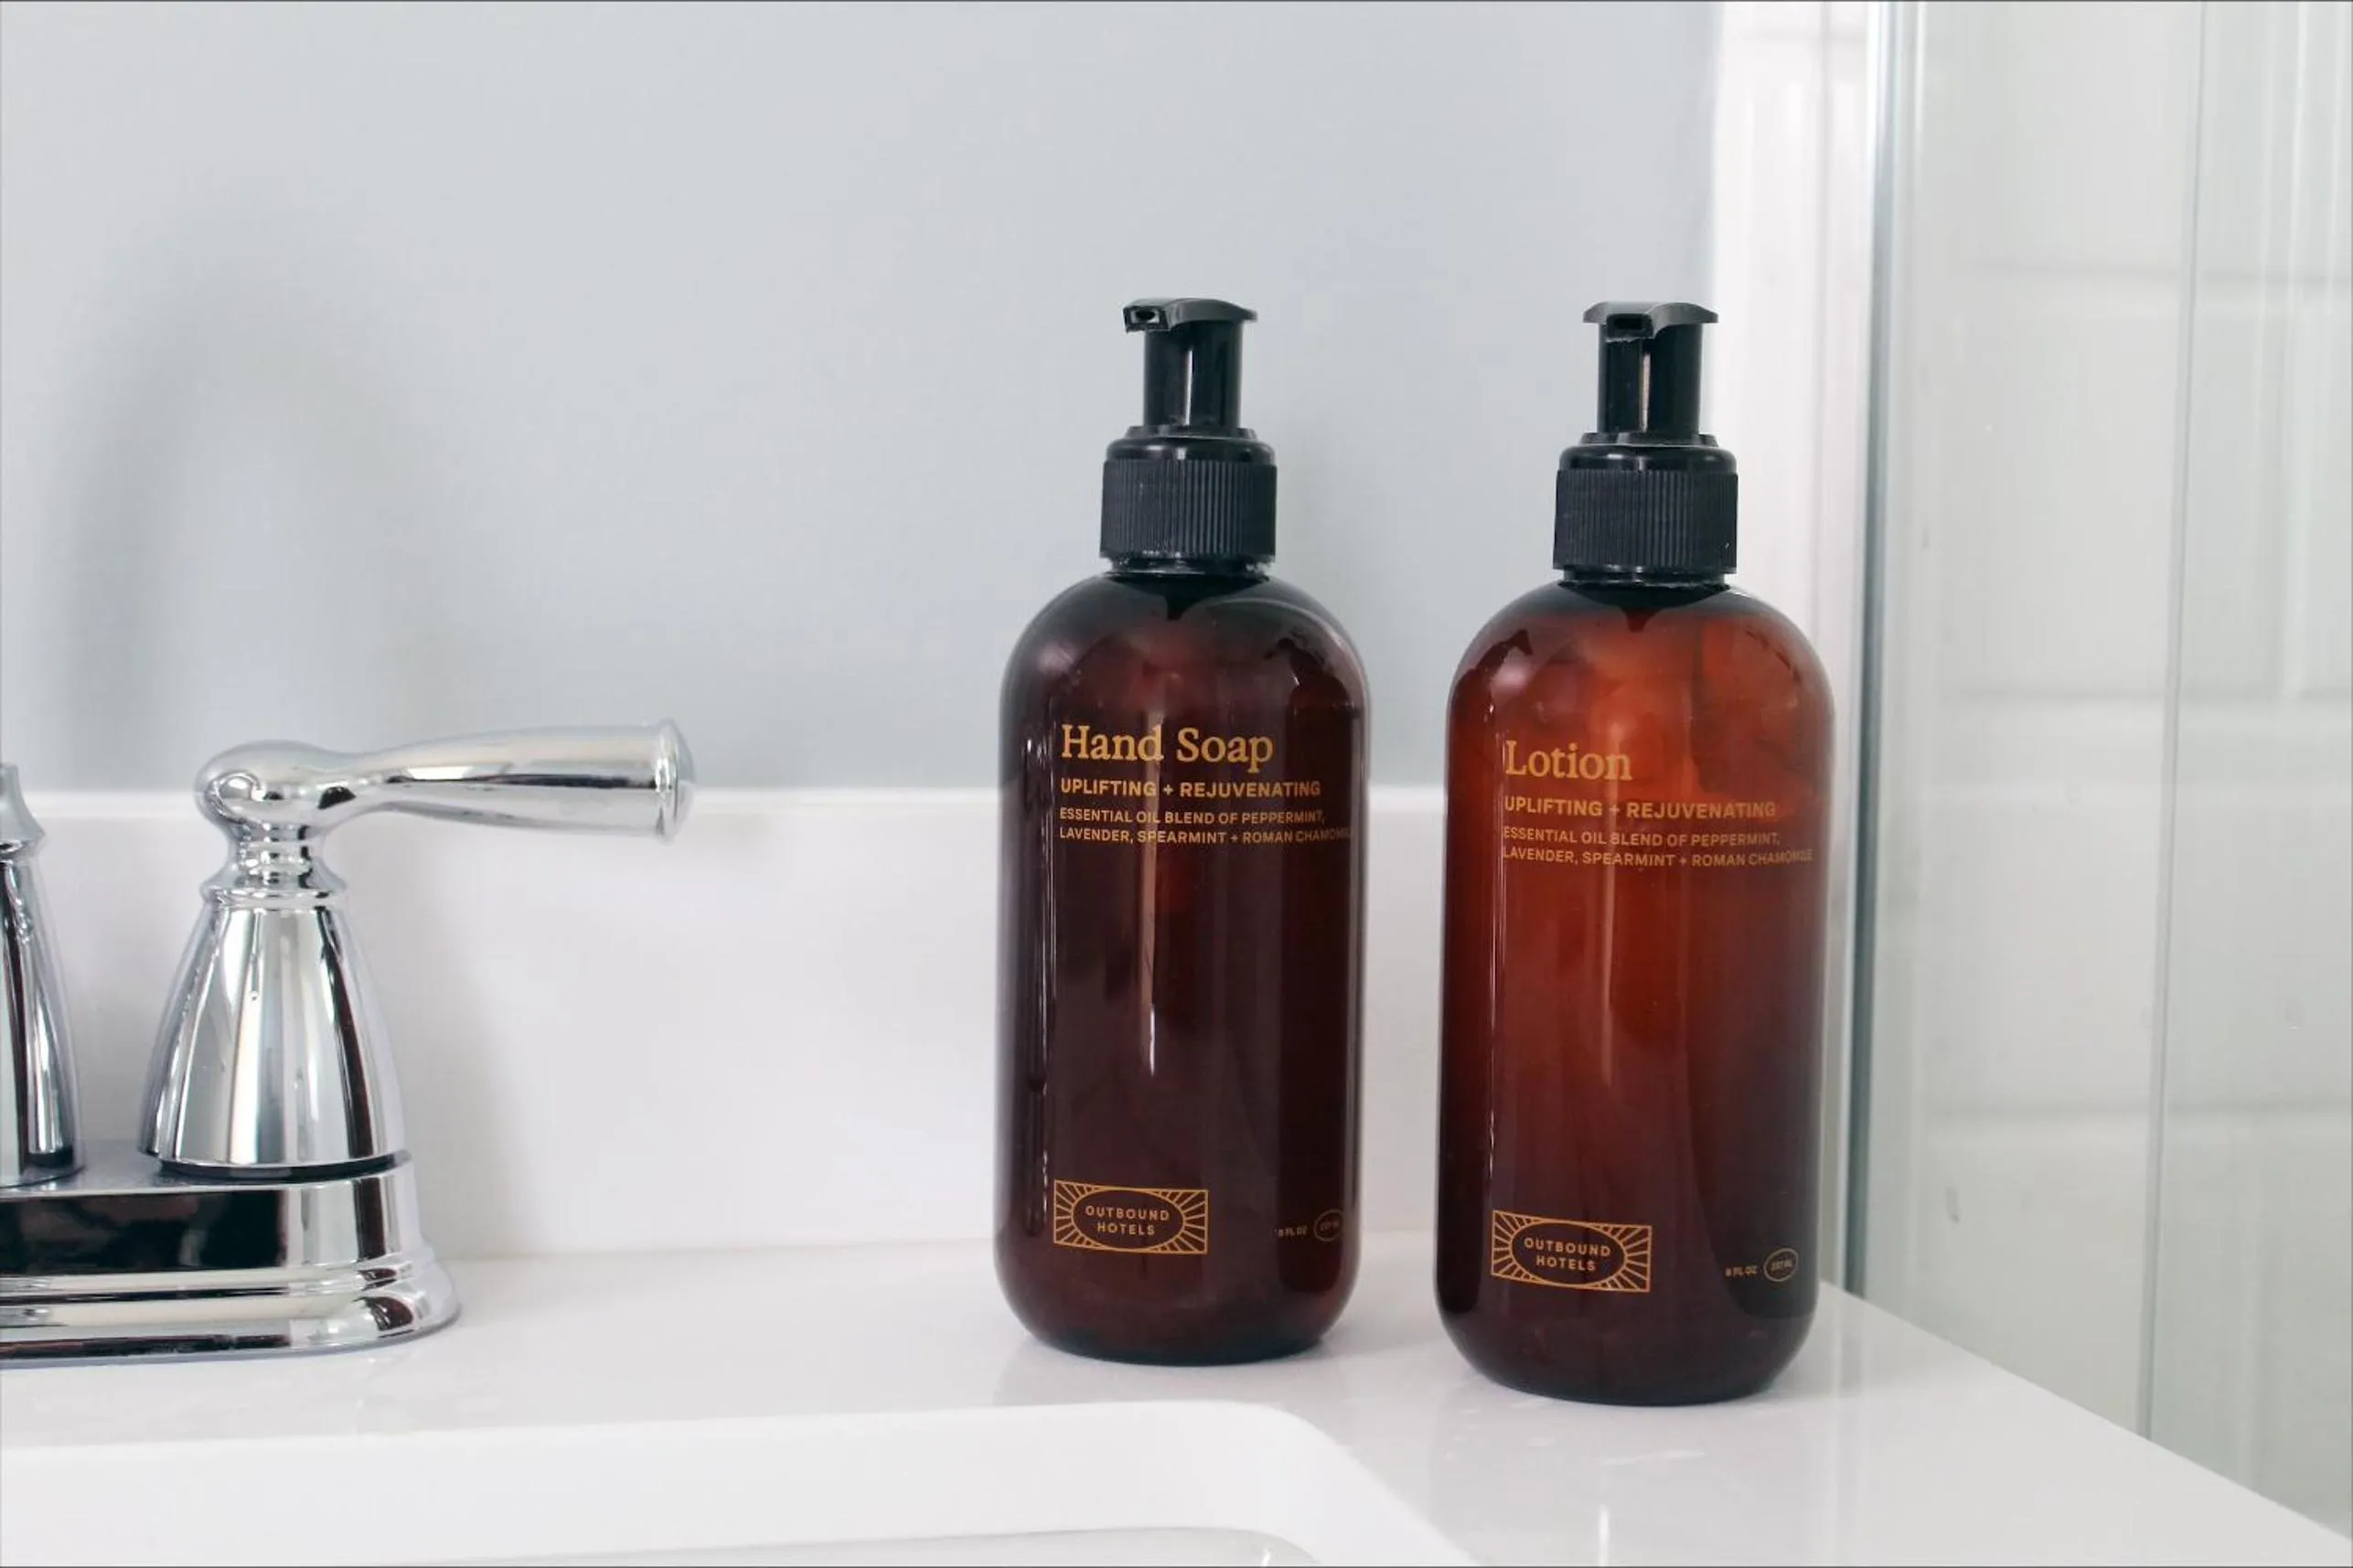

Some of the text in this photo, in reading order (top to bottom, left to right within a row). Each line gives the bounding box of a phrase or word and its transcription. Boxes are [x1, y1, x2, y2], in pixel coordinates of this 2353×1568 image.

[1061, 723, 1273, 773] Hand Soap
[1505, 740, 1632, 781] Lotion
[1061, 777, 1321, 798] UPLIFTING + REJUVENATING
[1060, 806, 1325, 825] ESSENTIAL OIL BLEND OF PEPPERMINT,
[1504, 795, 1777, 819] UPLIFTING + REJUVENATING
[1060, 827, 1133, 844] LAVENDER,
[1138, 830, 1226, 844] SPEARMINT
[1231, 834, 1238, 842] +
[1243, 831, 1292, 844] ROMAN
[1503, 826, 1781, 848] ESSENTIAL OIL BLEND OF PEPPERMINT,
[1503, 846, 1578, 865] LAVENDER,
[1582, 850, 1676, 867] SPEARMINT
[1680, 857, 1688, 866] +
[1692, 853, 1746, 868] ROMAN
[1086, 1205, 1170, 1221] OUTBOUND
[1096, 1221, 1155, 1235] HOTELS
[1524, 1236, 1612, 1258] OUTBOUND
[1536, 1254, 1598, 1272] HOTELS
